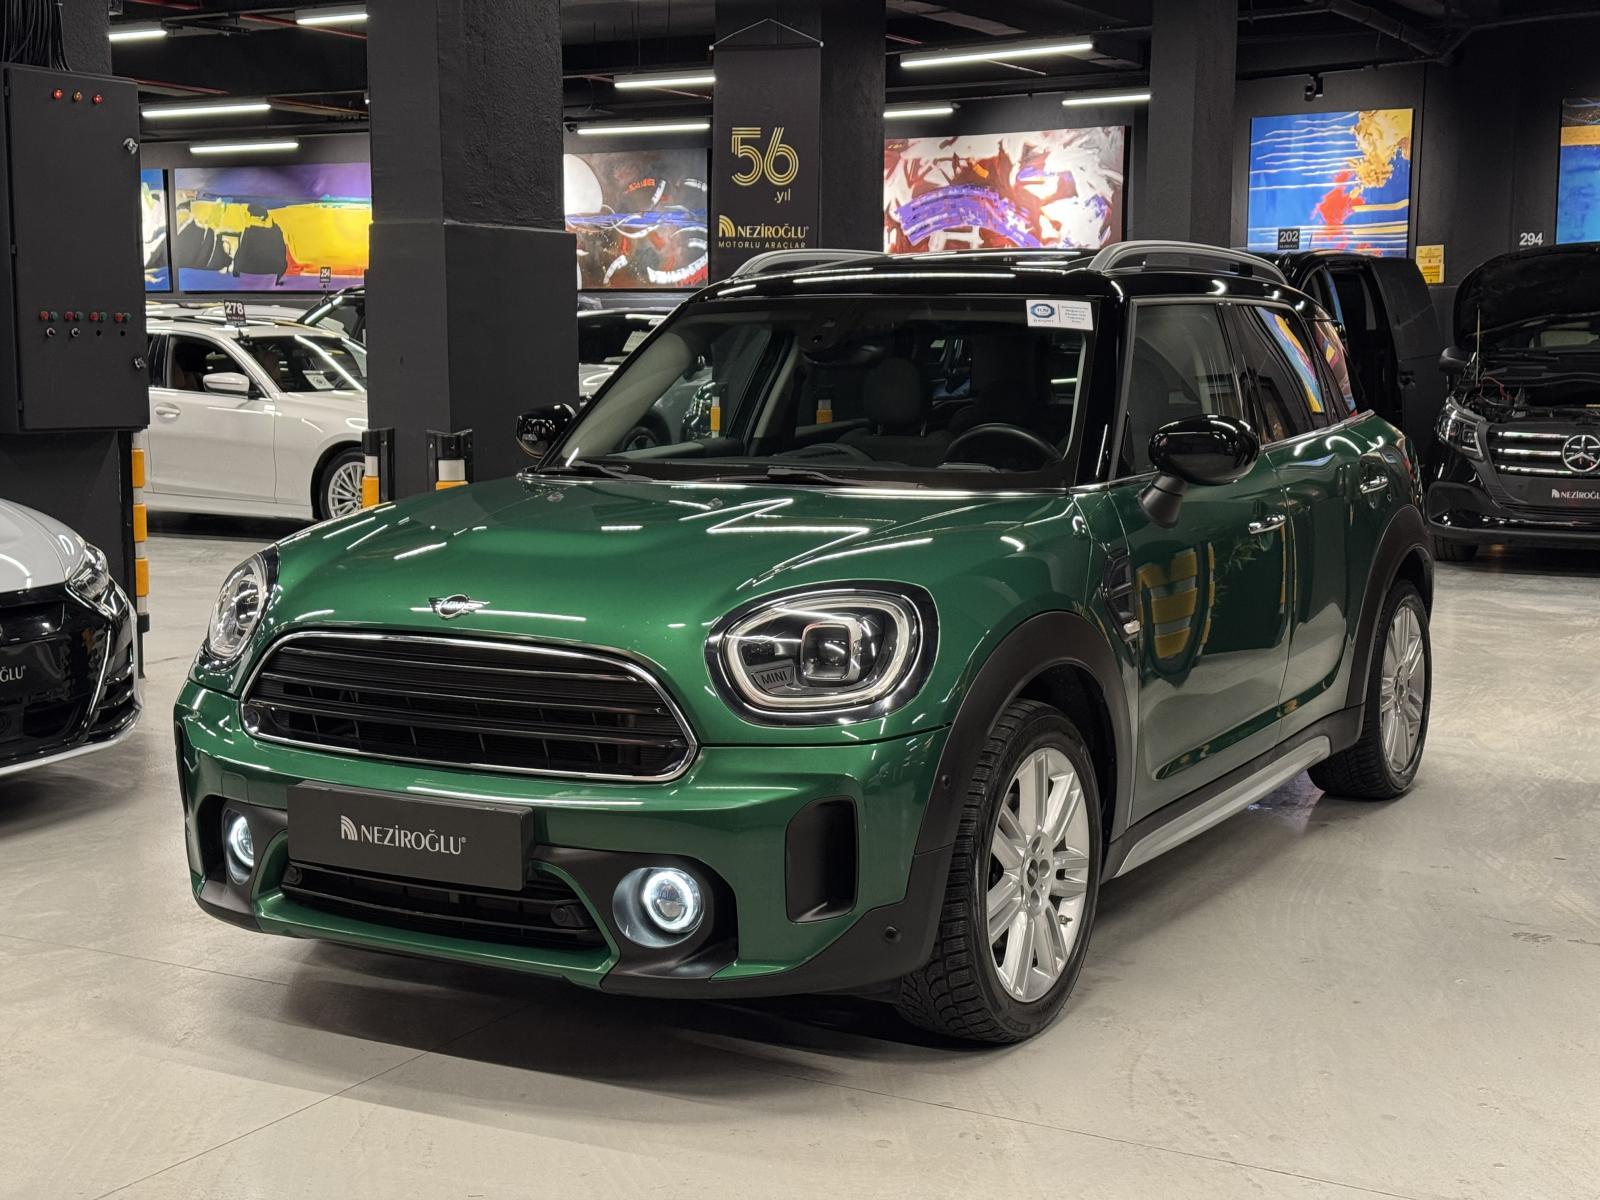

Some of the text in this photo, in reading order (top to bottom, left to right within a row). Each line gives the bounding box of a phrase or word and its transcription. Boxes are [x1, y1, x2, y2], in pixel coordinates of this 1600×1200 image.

[732, 127, 799, 186] 56
[737, 223, 806, 239] NEZİROĞLU
[1279, 231, 1299, 243] 202
[718, 241, 806, 250] MOTORLU ARAÇLAR
[1519, 232, 1543, 246] 294
[225, 301, 244, 315] 278
[760, 671, 788, 685] MINI
[360, 824, 462, 855] NEZİROĞLU
